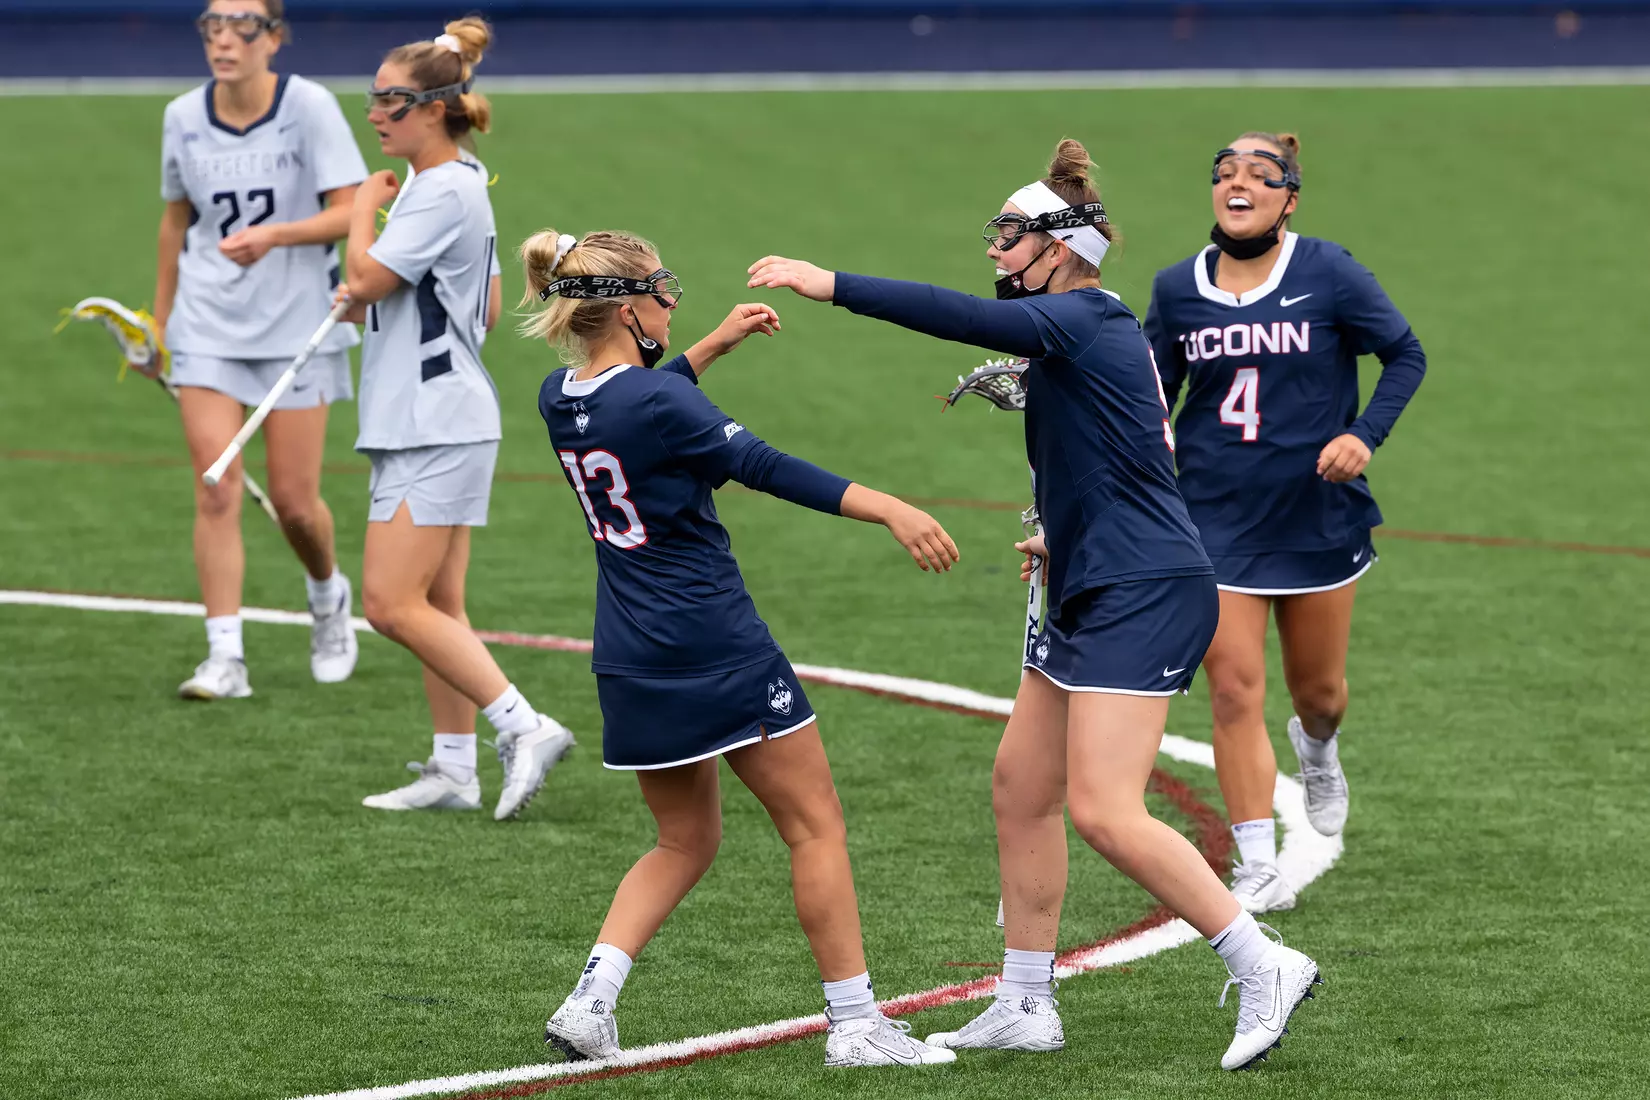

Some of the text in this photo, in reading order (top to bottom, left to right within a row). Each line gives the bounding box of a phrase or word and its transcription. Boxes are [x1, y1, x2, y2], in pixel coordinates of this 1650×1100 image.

[212, 188, 275, 238] 22
[1025, 219, 1041, 231] TX
[1093, 214, 1108, 224] ST
[592, 276, 625, 288] STX
[635, 281, 653, 293] ST
[1178, 321, 1310, 362] UCONN
[1218, 366, 1261, 442] 4
[557, 448, 649, 550] 13
